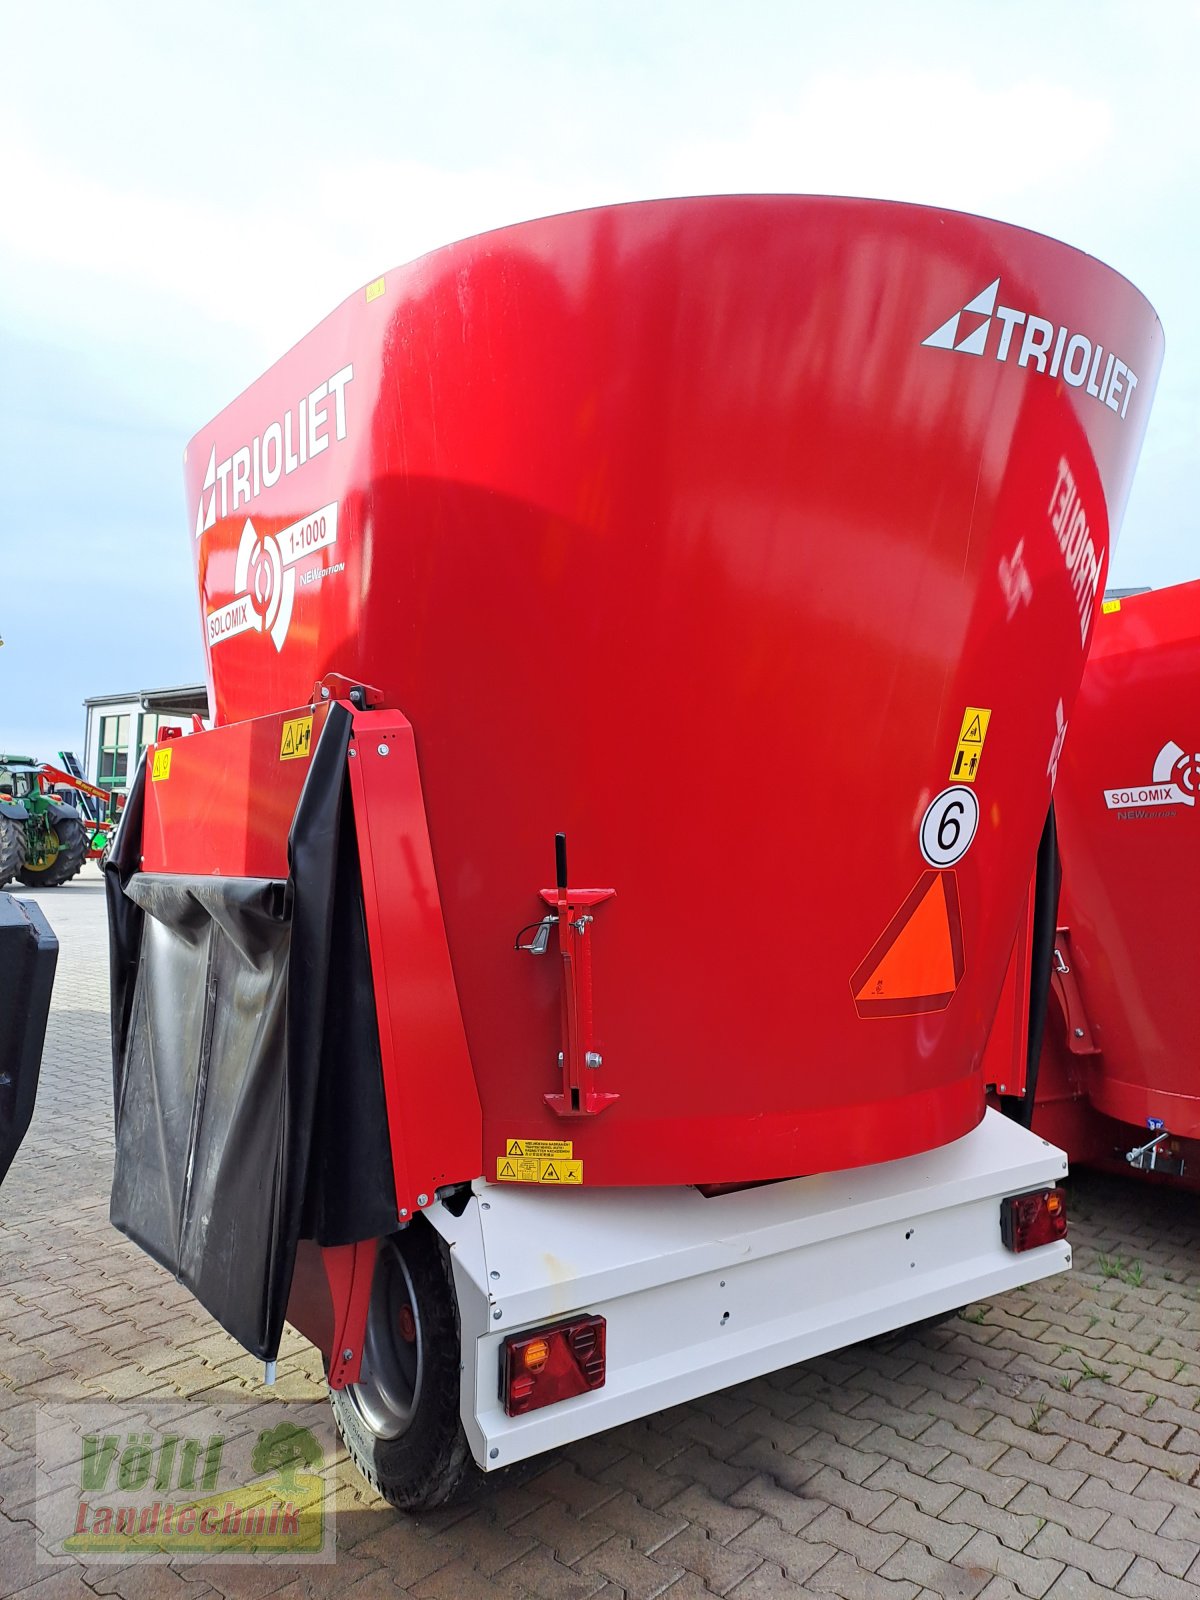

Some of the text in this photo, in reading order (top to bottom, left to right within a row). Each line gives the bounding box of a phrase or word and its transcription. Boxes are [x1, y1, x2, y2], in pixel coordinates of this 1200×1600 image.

[996, 305, 1139, 420] TRIOLIET
[216, 362, 354, 520] TRIOLIET
[289, 516, 327, 554] 1-1000
[210, 603, 248, 639] SOLOMIX
[1111, 788, 1173, 805] SOLOMIX
[937, 801, 964, 851] 6
